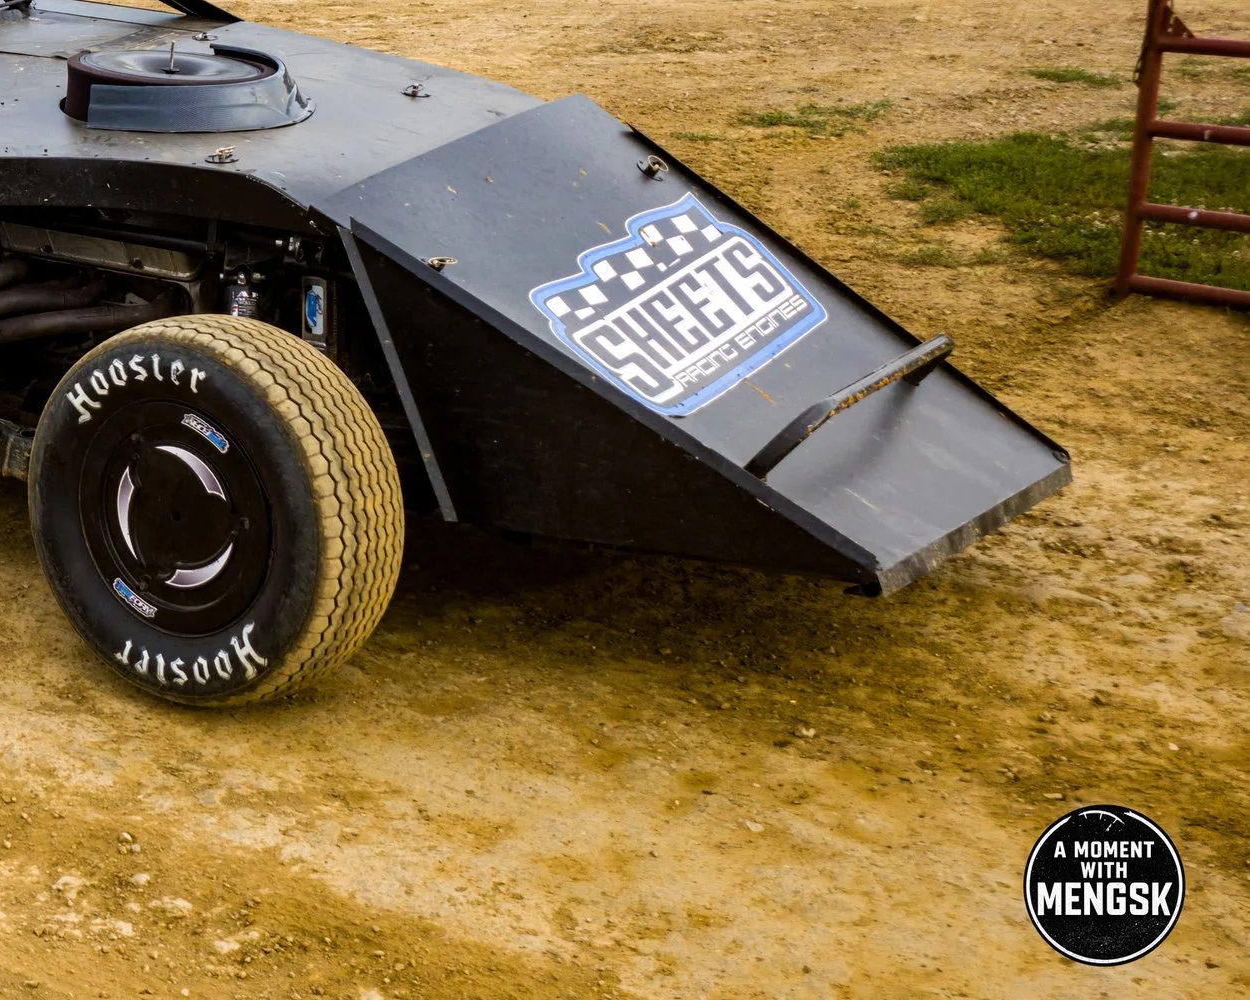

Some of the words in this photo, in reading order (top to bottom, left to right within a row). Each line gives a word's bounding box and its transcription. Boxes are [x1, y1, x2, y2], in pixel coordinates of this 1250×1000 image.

[572, 236, 794, 404] SHEETS
[674, 343, 738, 387] RACING
[734, 295, 807, 350] ENGINES
[66, 354, 209, 424] Hoosier
[114, 623, 268, 685] Hoosier
